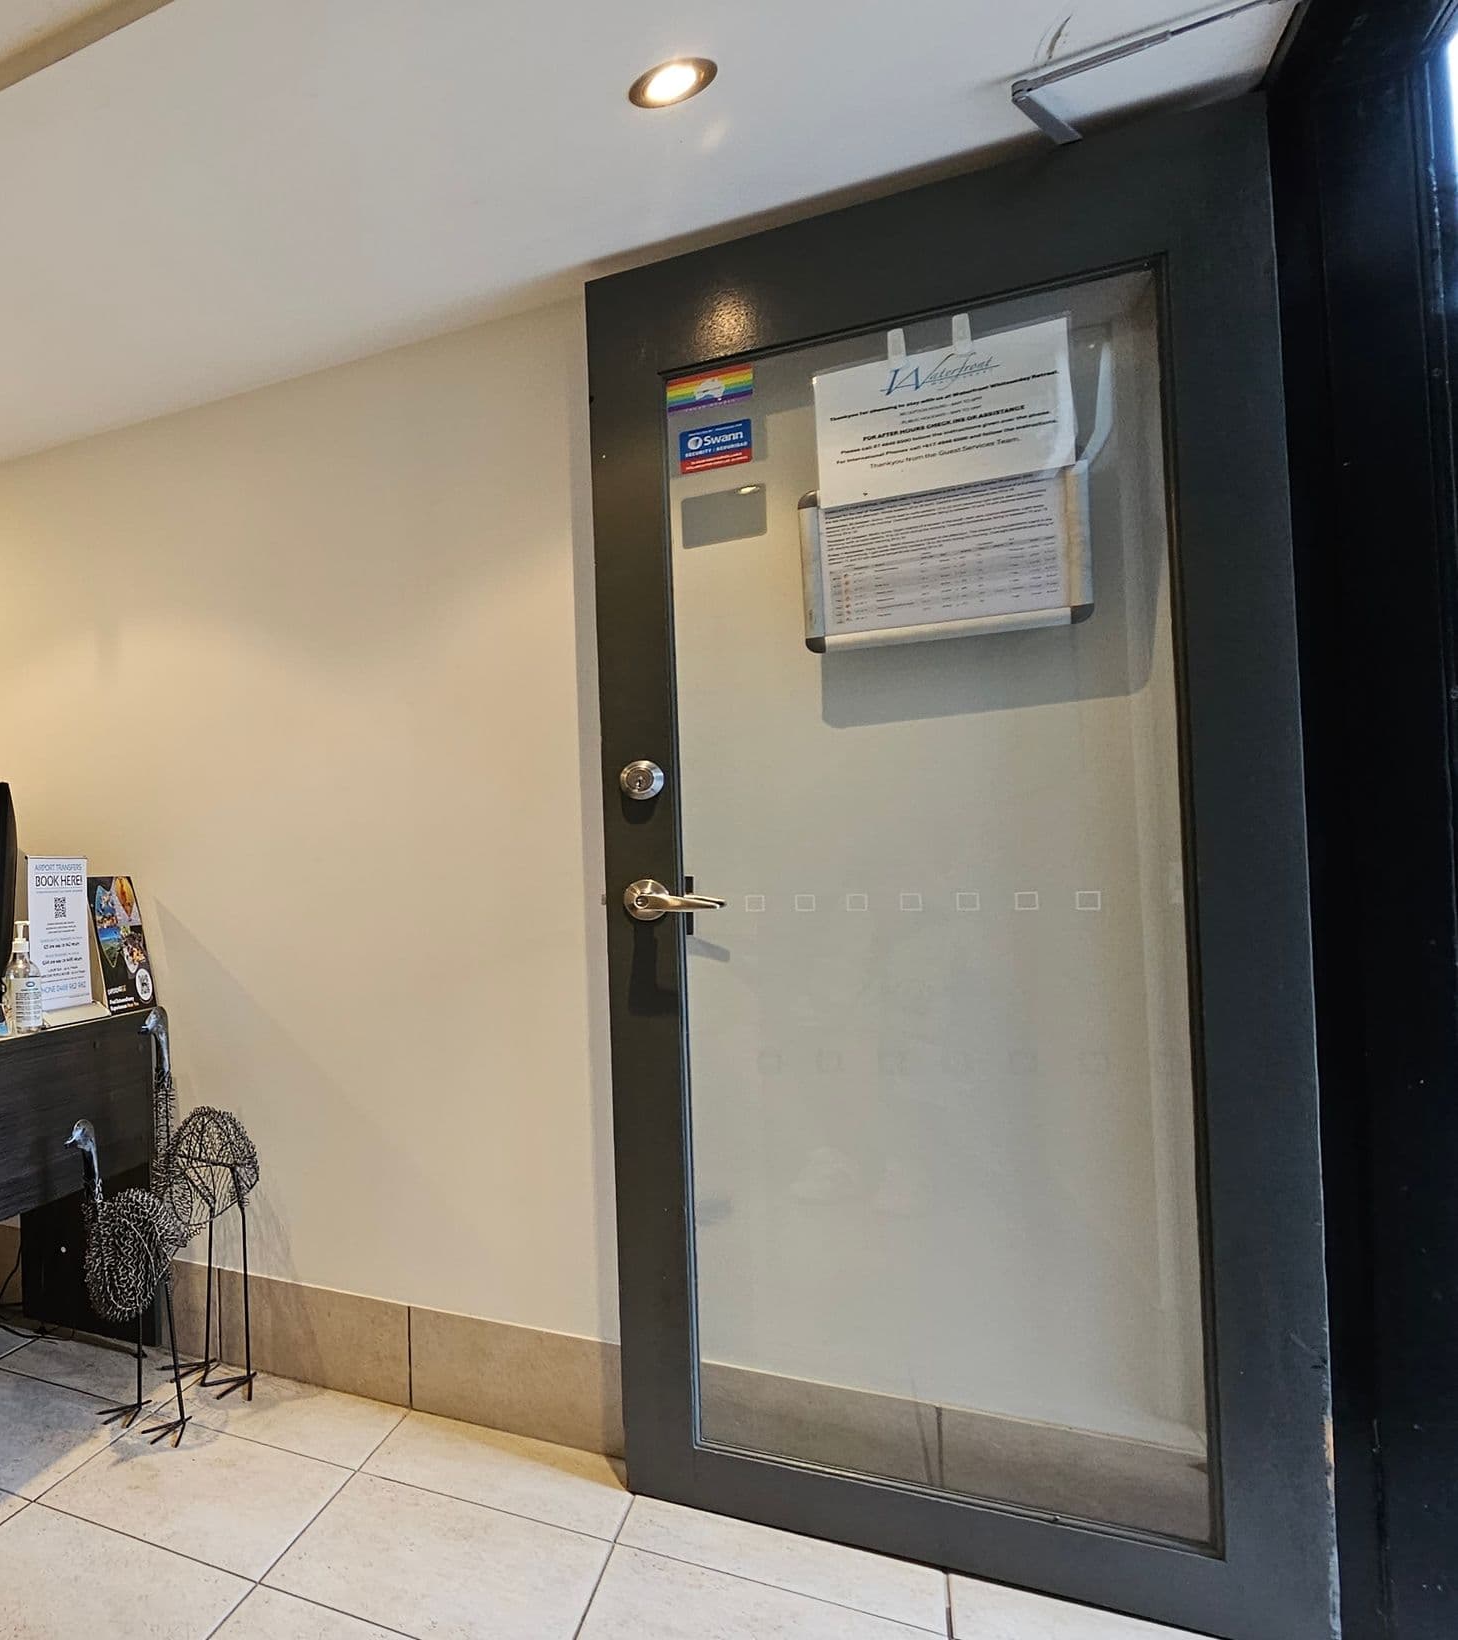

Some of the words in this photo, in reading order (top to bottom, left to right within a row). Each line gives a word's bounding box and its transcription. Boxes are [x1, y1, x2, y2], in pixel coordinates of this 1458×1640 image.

[863, 434, 876, 442] FOR
[877, 430, 898, 439] AFTER
[899, 425, 925, 435] HOURS
[926, 418, 952, 430] CHECK
[978, 404, 1025, 419] ASSISTANCE
[703, 431, 744, 446] Swann
[685, 448, 712, 458] SECURITY
[938, 446, 961, 456] Guest
[962, 440, 995, 451] Services
[34, 863, 55, 872] AIRPORT
[55, 863, 83, 871] TRANSFERS
[35, 875, 59, 888] BOOK
[60, 874, 83, 887] HERE!
